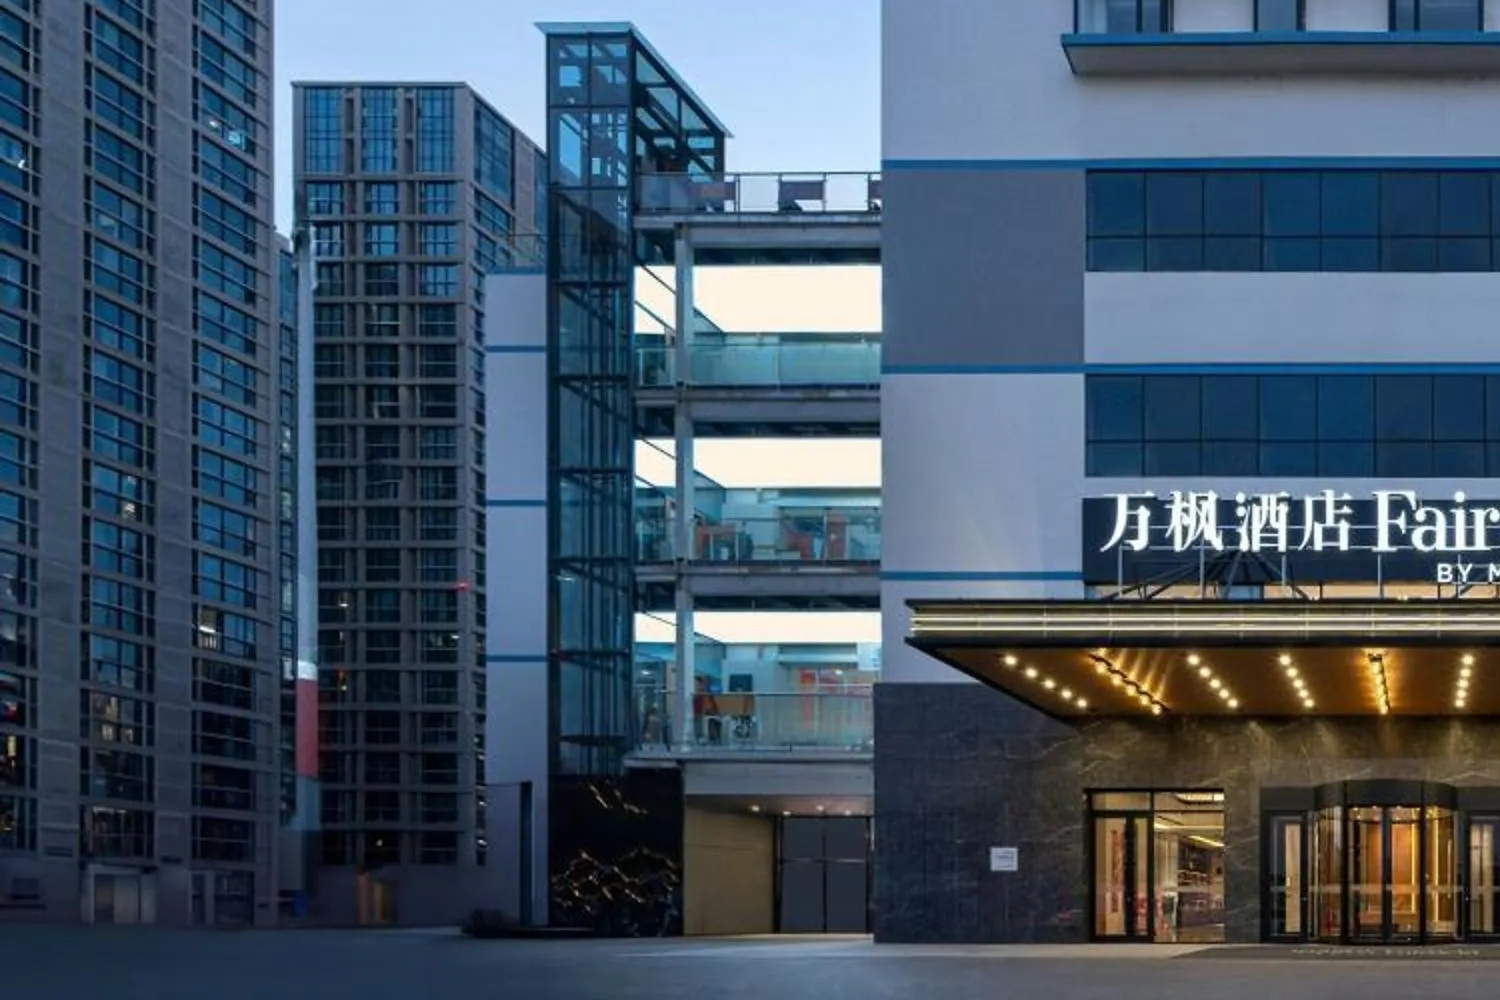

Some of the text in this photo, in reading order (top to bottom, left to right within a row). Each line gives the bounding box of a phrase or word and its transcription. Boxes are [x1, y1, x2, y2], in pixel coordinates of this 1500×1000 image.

[1100, 489, 1353, 552] 万枫酒店
[1437, 562, 1473, 583] BY
